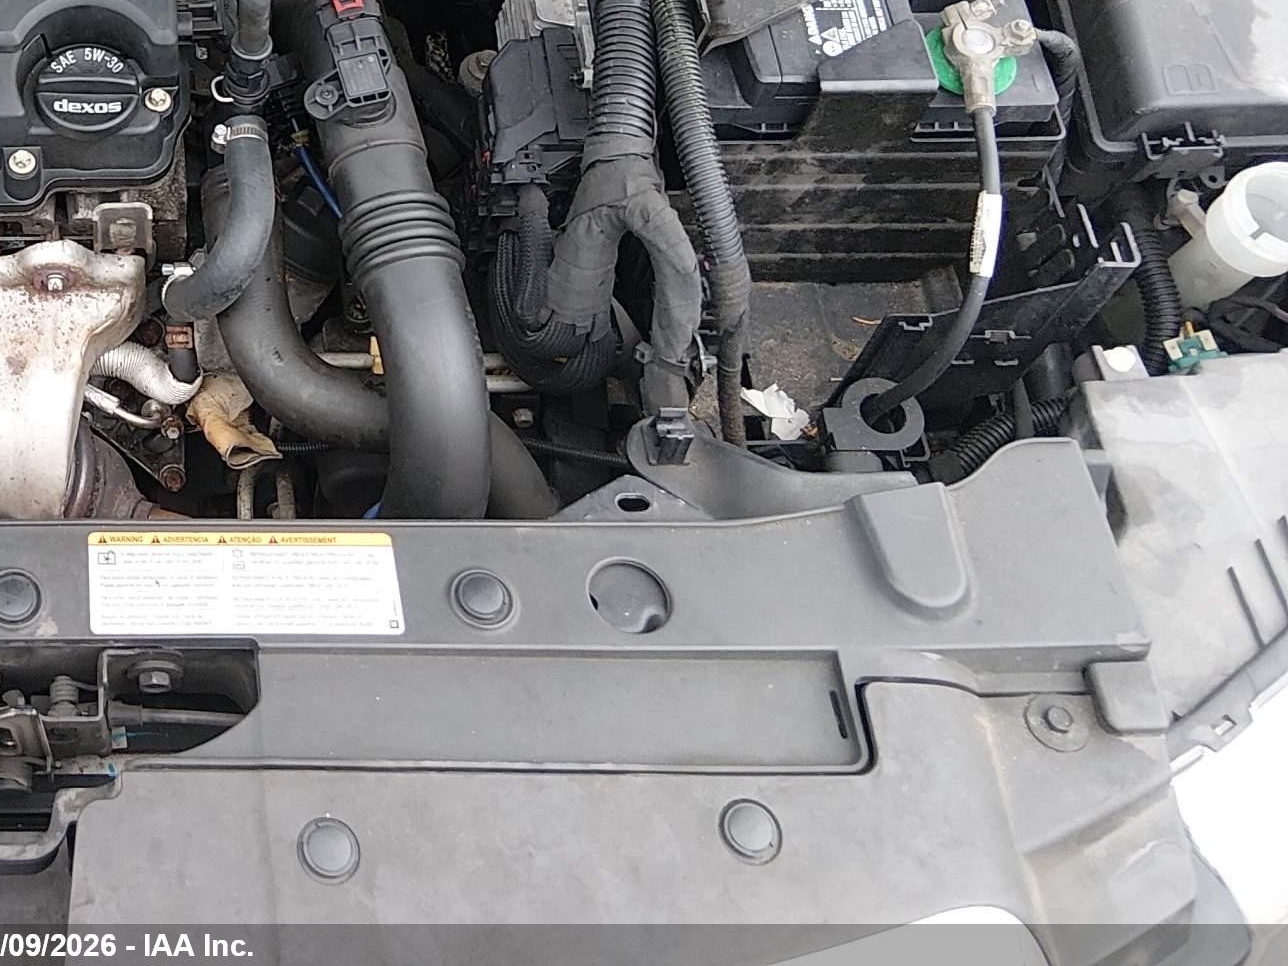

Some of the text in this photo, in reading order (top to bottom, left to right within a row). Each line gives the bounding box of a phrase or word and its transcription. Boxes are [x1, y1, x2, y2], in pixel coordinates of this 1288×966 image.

[50, 47, 124, 73] SAE 5W-30
[53, 98, 122, 114] dexos
[109, 535, 143, 543] WARNING
[162, 535, 209, 544] ADVERTENCIA
[280, 535, 336, 544] AVERTISSEMENT
